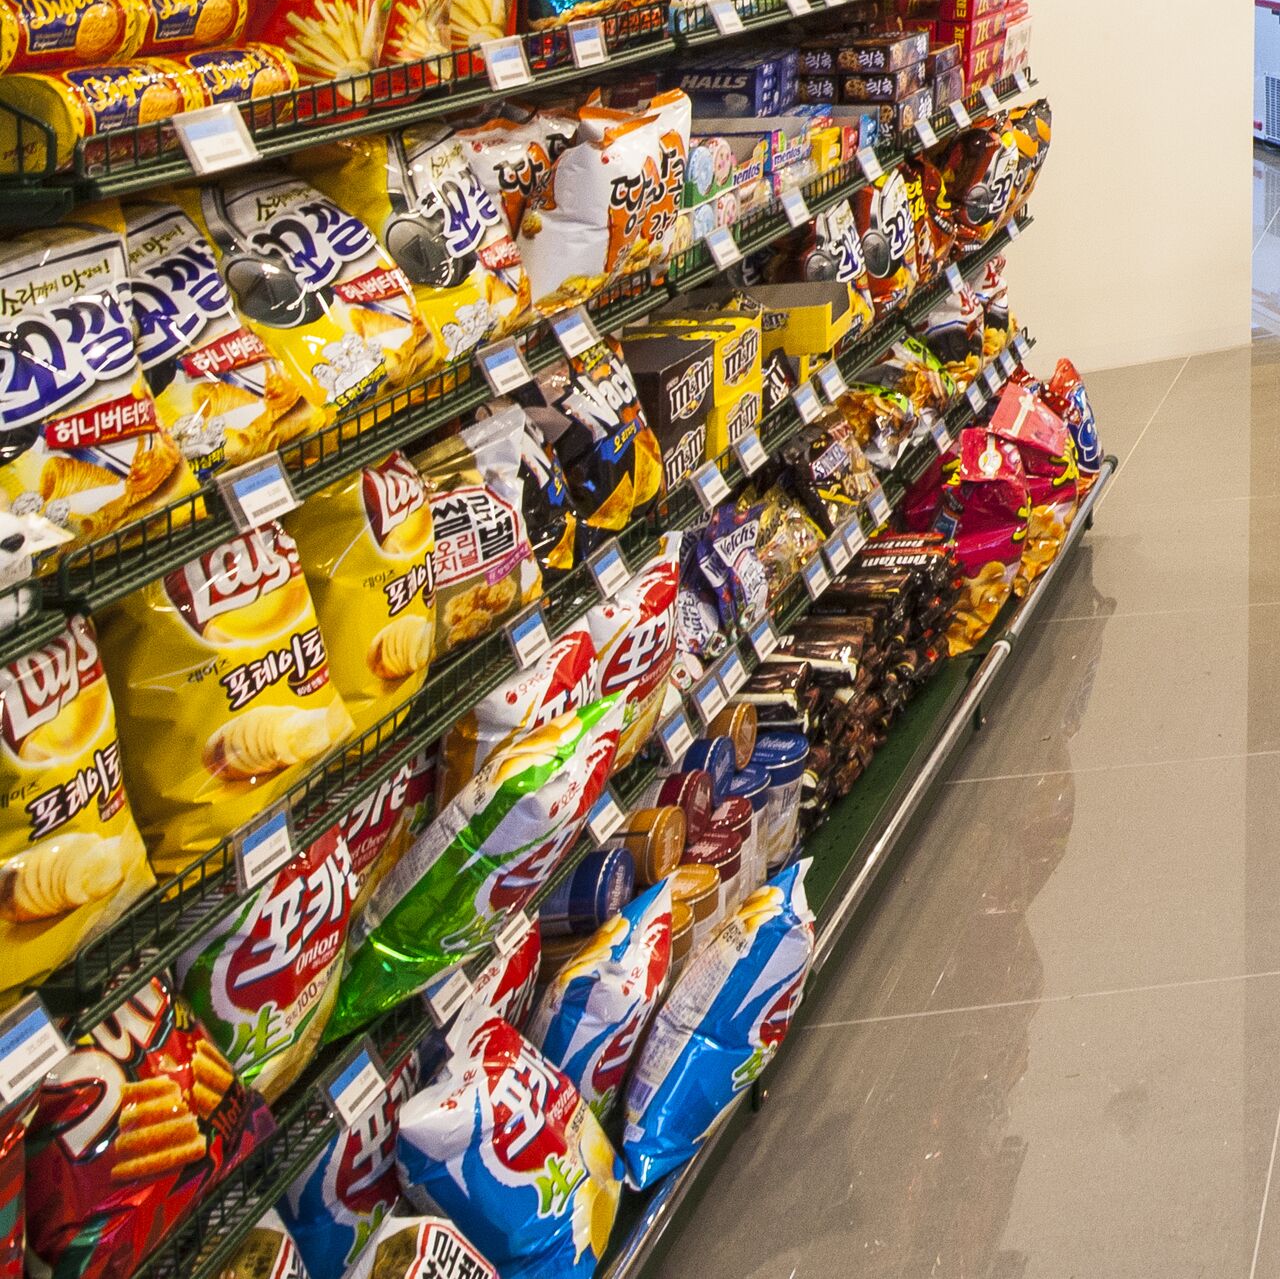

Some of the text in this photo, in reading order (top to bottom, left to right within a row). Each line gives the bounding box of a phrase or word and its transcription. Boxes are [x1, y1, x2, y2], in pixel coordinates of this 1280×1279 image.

[681, 73, 748, 90] HALLS
[772, 145, 801, 167] mentos
[62, 258, 111, 294] 맛있다!
[54, 399, 153, 447] 허니버터맛
[720, 523, 756, 554] Welch's
[219, 625, 327, 712] 포테이토
[296, 929, 339, 975] Onion
